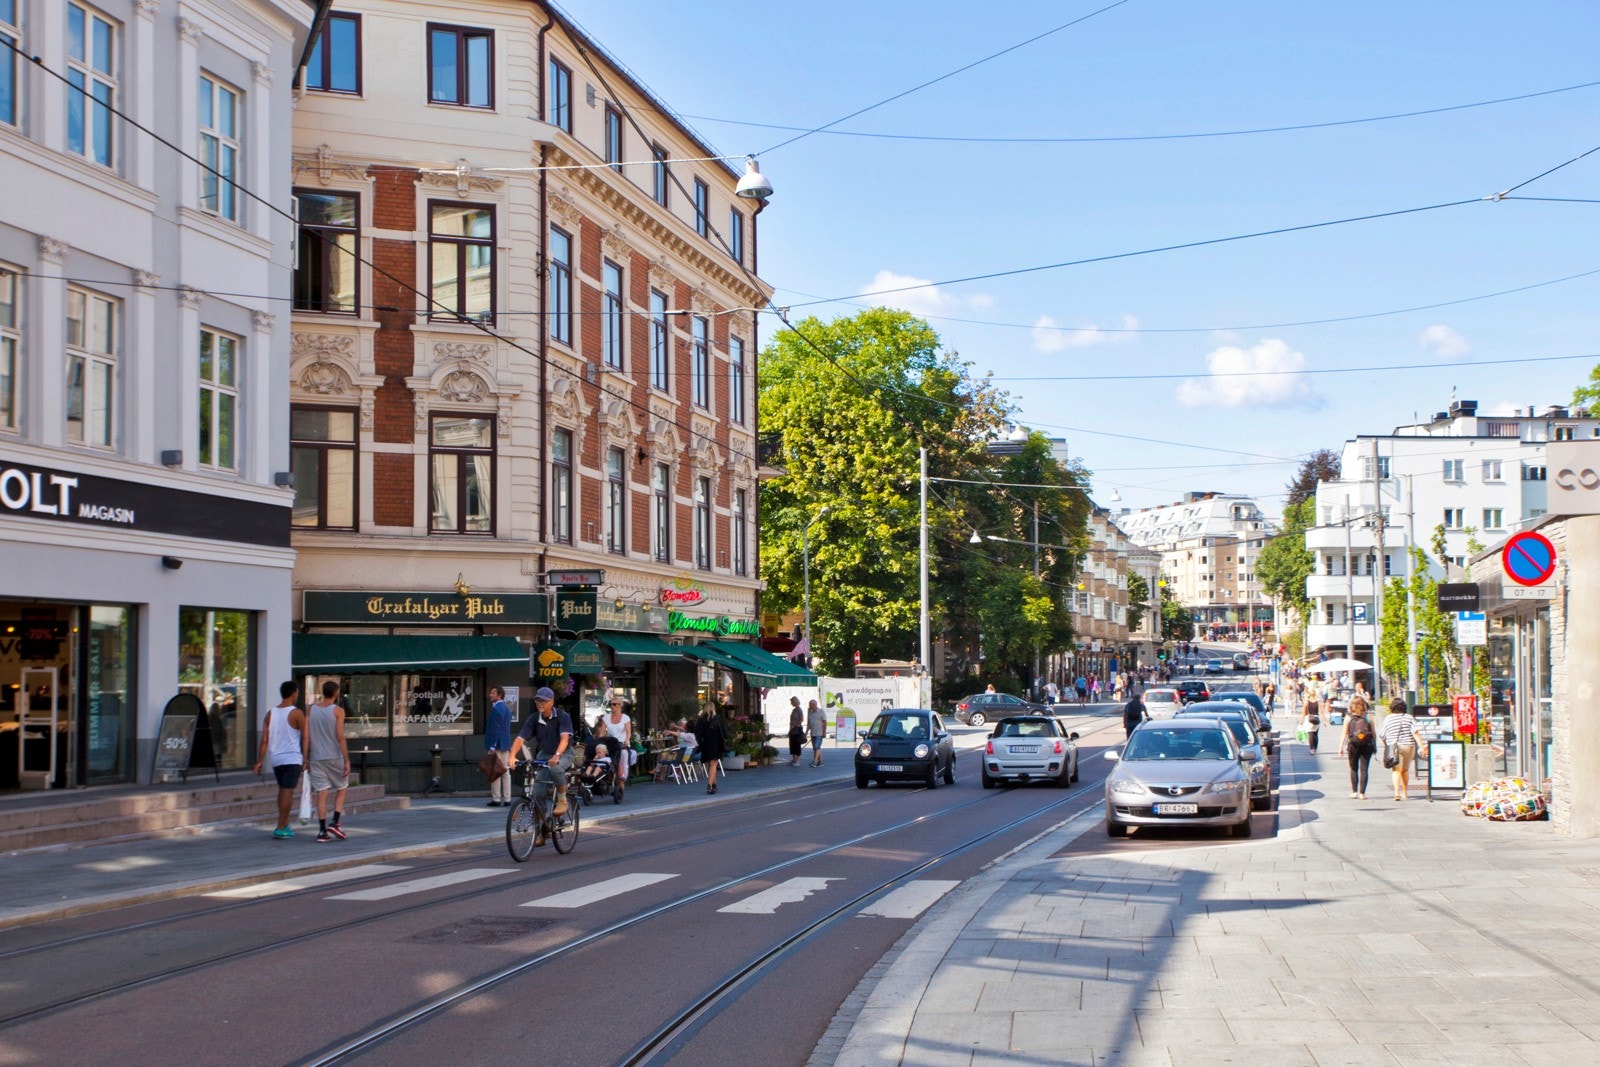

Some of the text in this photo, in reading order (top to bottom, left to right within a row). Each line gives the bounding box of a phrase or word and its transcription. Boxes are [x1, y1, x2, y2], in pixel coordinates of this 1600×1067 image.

[0, 468, 78, 515] OLT
[79, 503, 134, 523] MAGASIN
[661, 588, 702, 603] Blomster
[1514, 589, 1525, 597] 07
[1538, 589, 1546, 597] 17
[366, 597, 504, 619] Trafalgar Pub
[561, 599, 592, 619] Pub
[1354, 606, 1365, 617] P
[668, 611, 720, 635] Blomster
[539, 667, 564, 677] TOTO
[89, 637, 100, 749] SUMMER SALE
[407, 690, 444, 699] Football
[395, 714, 456, 723] TRAFALGAR
[162, 737, 189, 749] -50%
